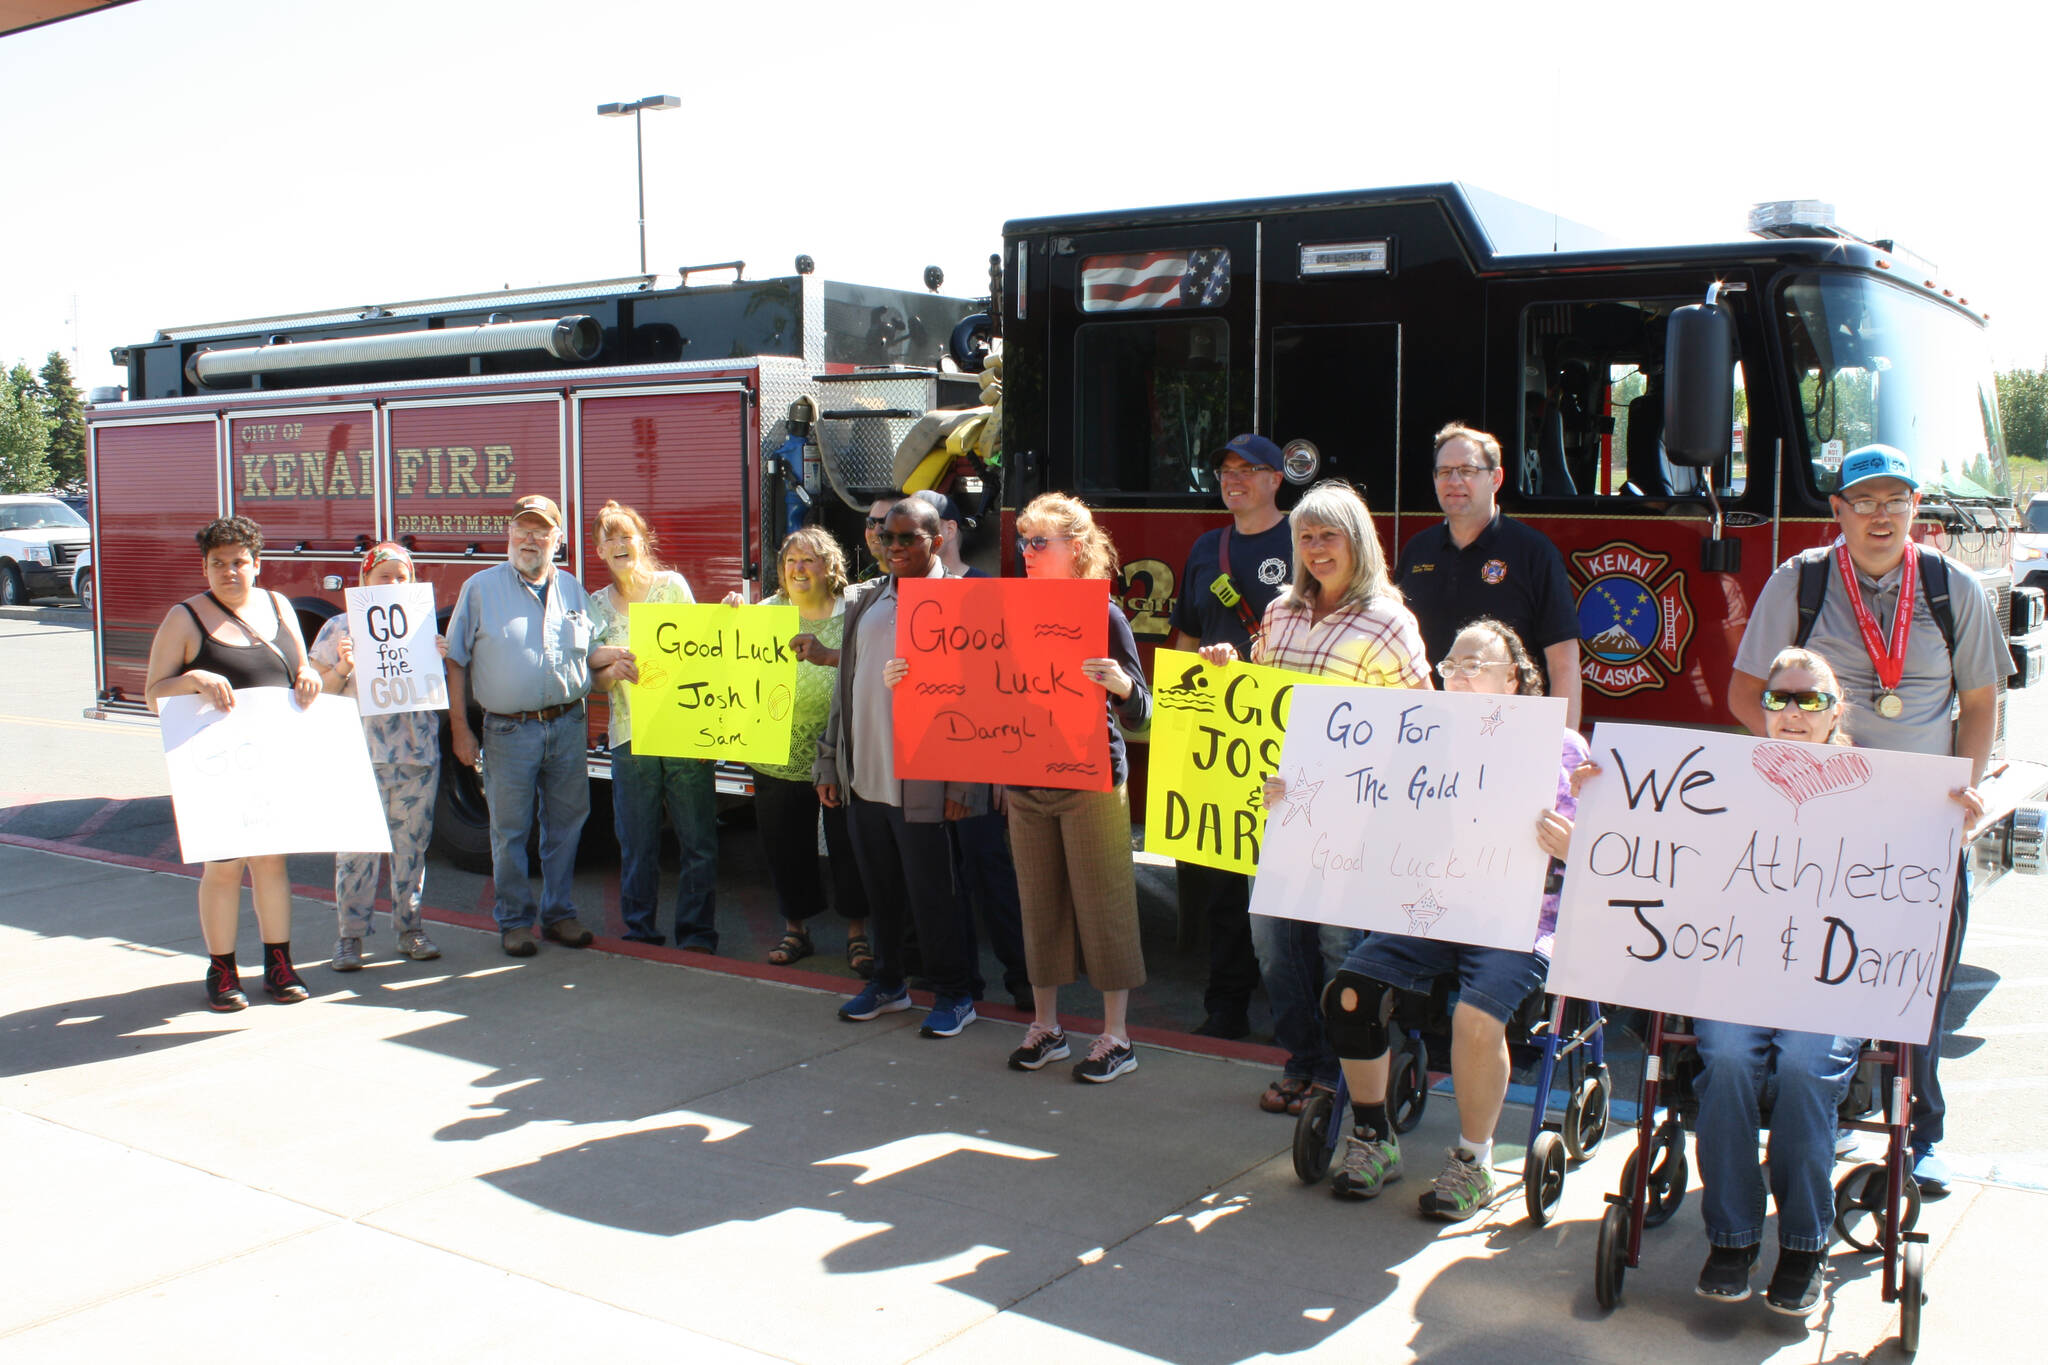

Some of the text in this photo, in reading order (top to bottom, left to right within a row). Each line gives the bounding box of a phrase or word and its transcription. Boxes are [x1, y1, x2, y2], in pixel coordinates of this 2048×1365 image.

[241, 422, 303, 443] CITY OF
[240, 444, 517, 497] KENAI FIRE
[1589, 554, 1651, 577] KENAI
[1123, 559, 1175, 636] 2
[367, 603, 409, 642] GO
[656, 622, 789, 664] Good Luck
[911, 599, 1009, 655] Good
[376, 643, 409, 661] for
[377, 661, 413, 678] the
[370, 673, 446, 709] GOLD
[994, 659, 1084, 697] Luck
[1581, 661, 1651, 687] ALASKA
[694, 727, 748, 748] Sam
[1397, 704, 1441, 745] For
[1345, 766, 1389, 808] The
[1610, 746, 1728, 815] We
[1164, 790, 1268, 866] DAR
[1311, 831, 1366, 880] Good
[1721, 827, 1954, 909] Athletes!
[1607, 899, 1942, 1016] Josh & Darryl
